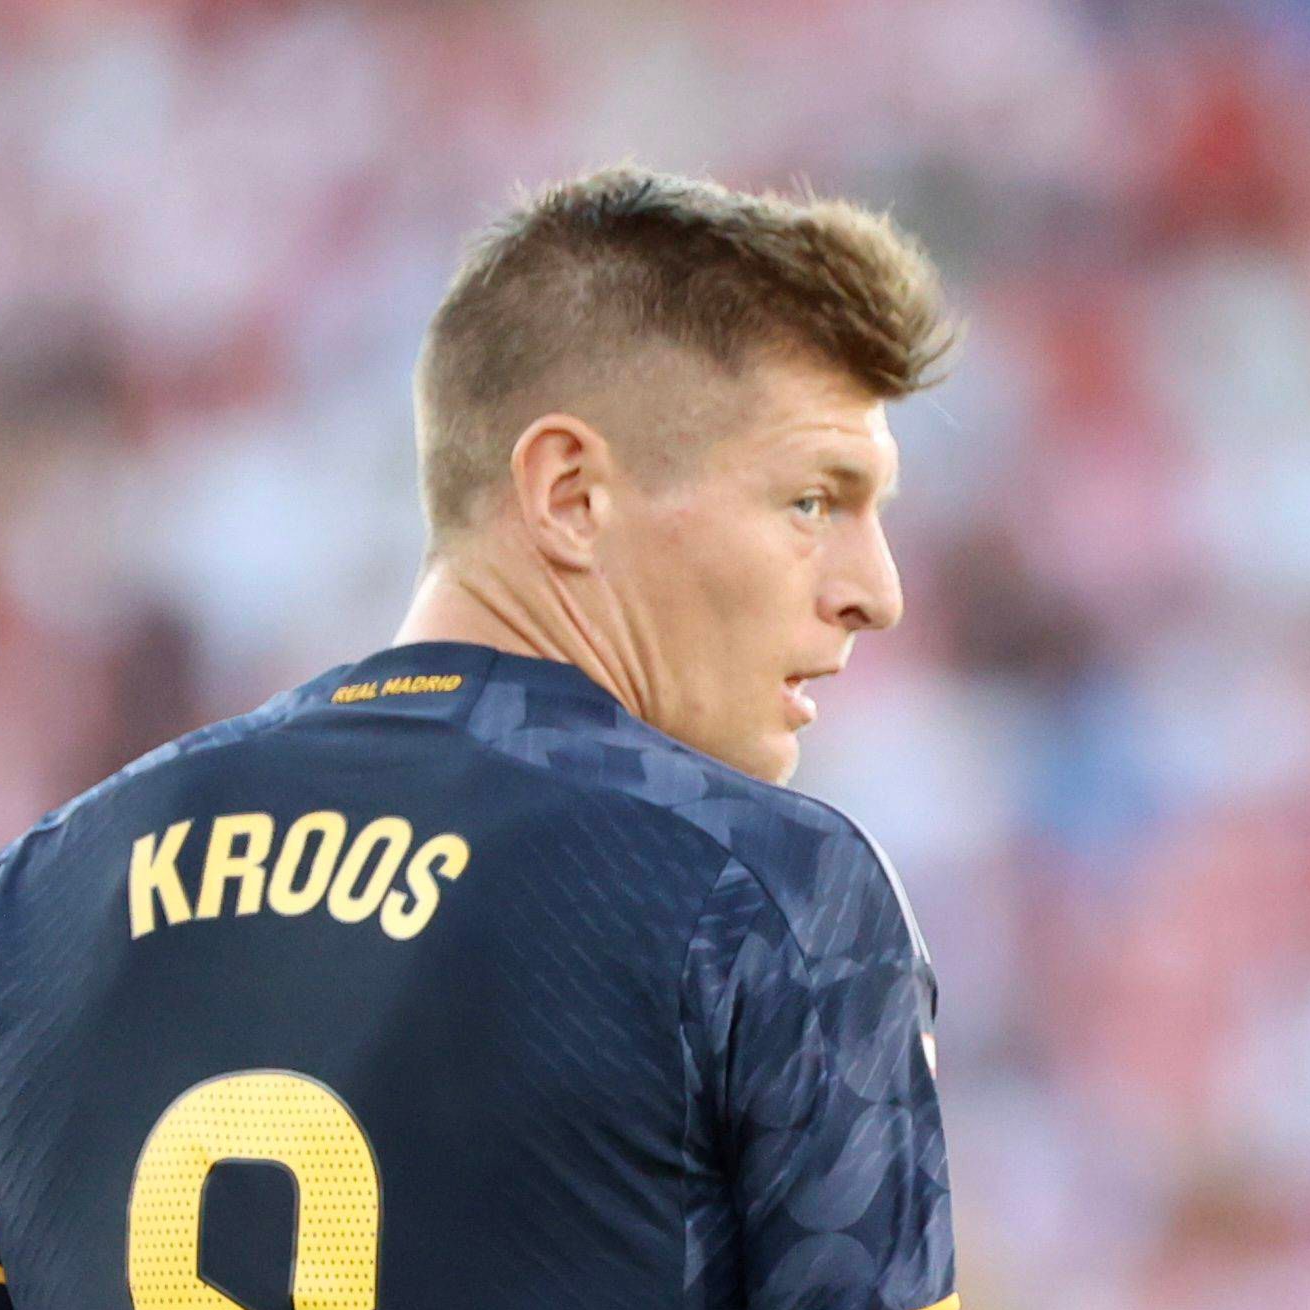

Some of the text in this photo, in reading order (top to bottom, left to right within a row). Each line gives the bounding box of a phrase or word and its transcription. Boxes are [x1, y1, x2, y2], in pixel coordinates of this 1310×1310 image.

[331, 674, 463, 704] REAL MADRID
[128, 811, 471, 940] KROOS
